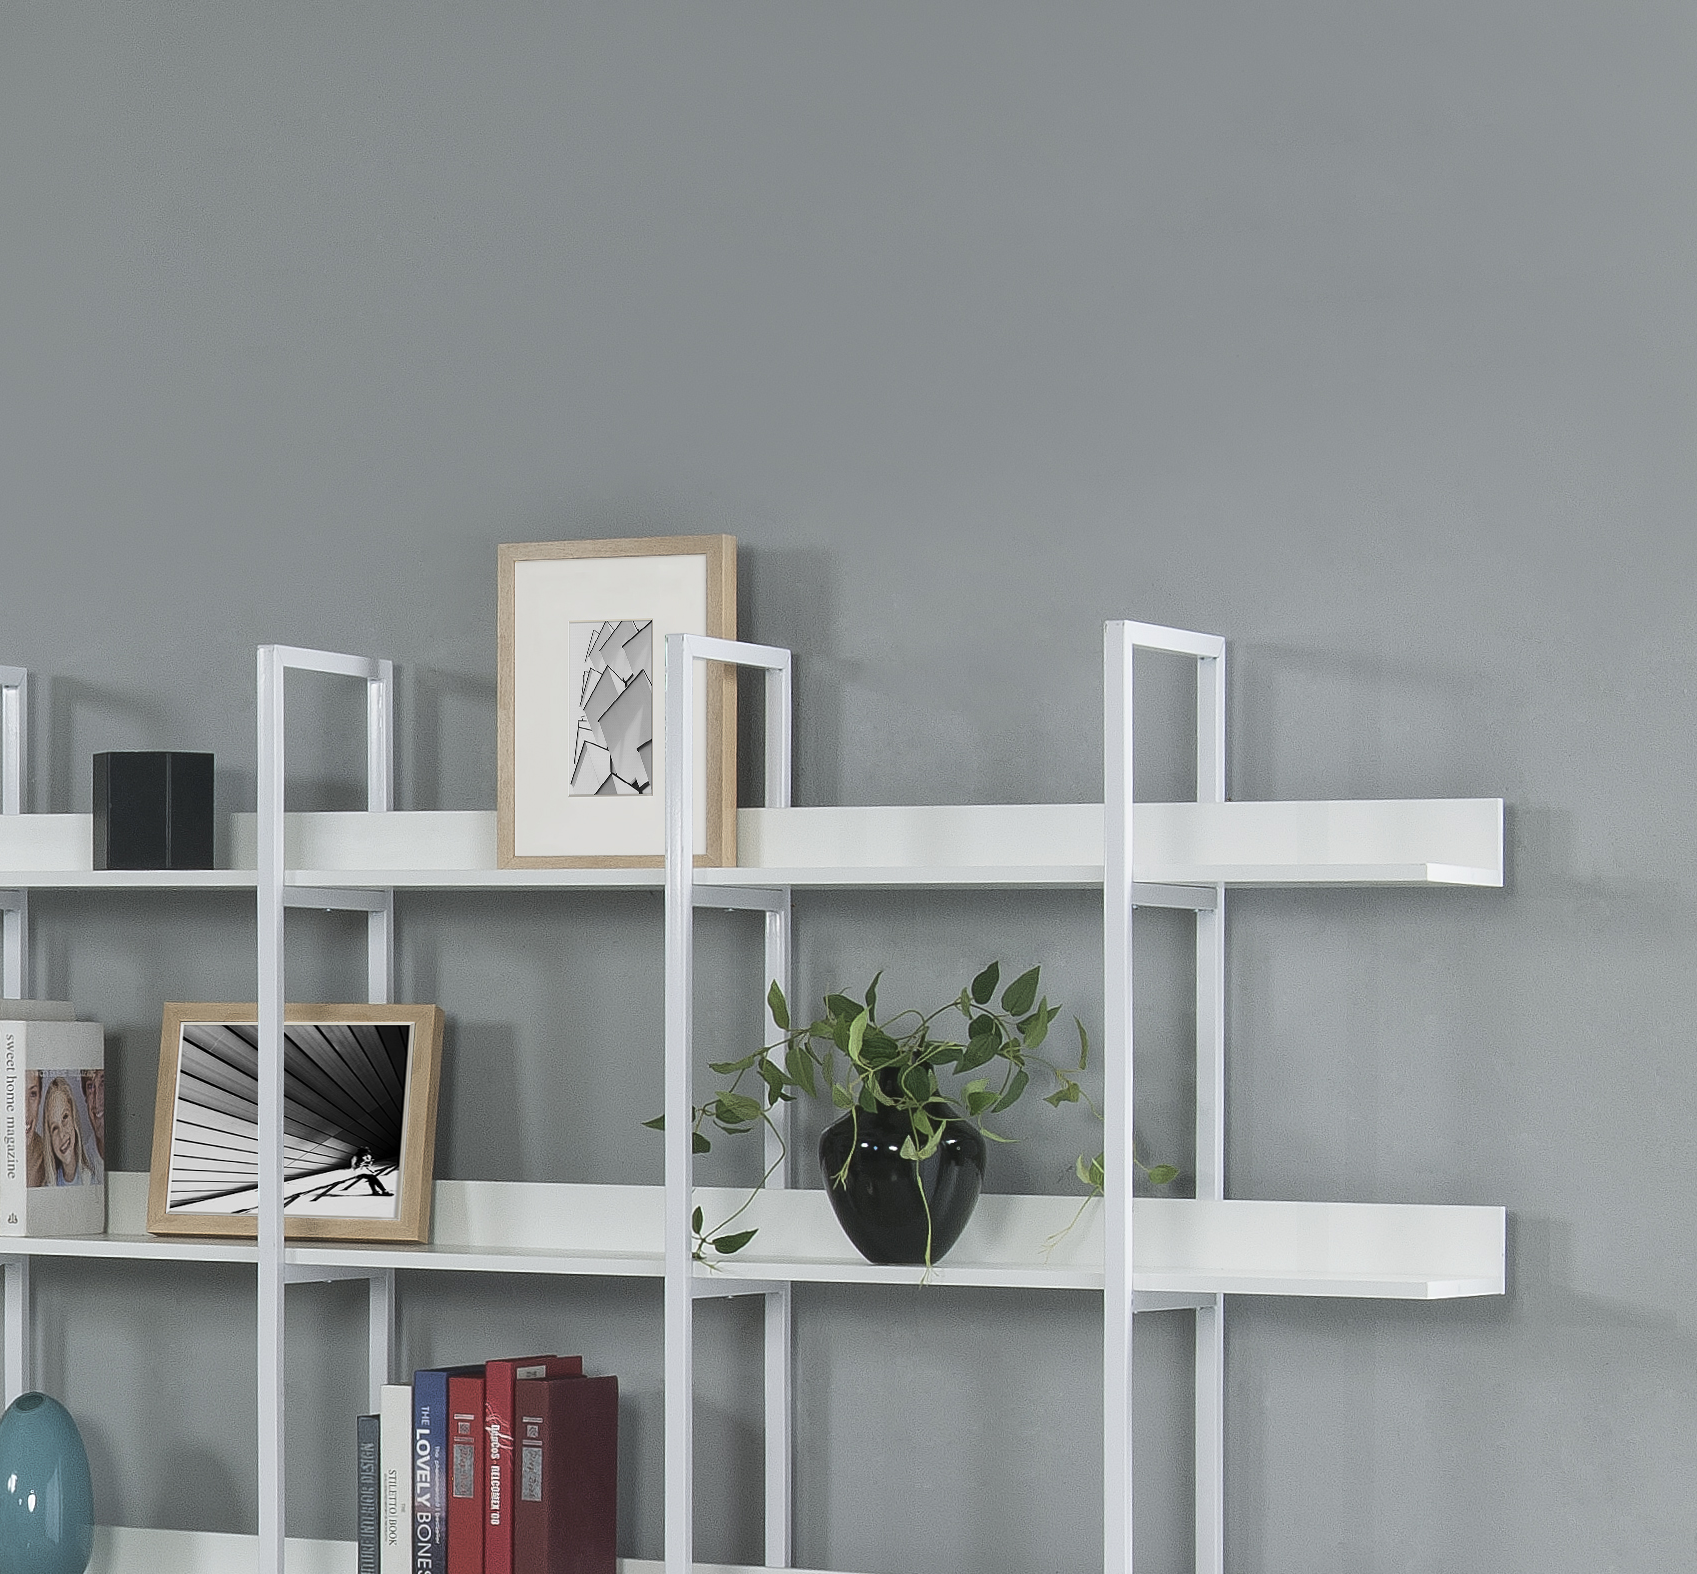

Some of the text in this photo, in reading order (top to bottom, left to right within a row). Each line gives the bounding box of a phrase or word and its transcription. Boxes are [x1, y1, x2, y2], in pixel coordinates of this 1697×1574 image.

[3, 1034, 18, 1179] sweet home magazine
[421, 1405, 430, 1426] THE
[360, 1441, 375, 1484] DESIGN
[416, 1428, 431, 1508] LOVELY
[388, 1469, 398, 1546] STILETTO BOOK
